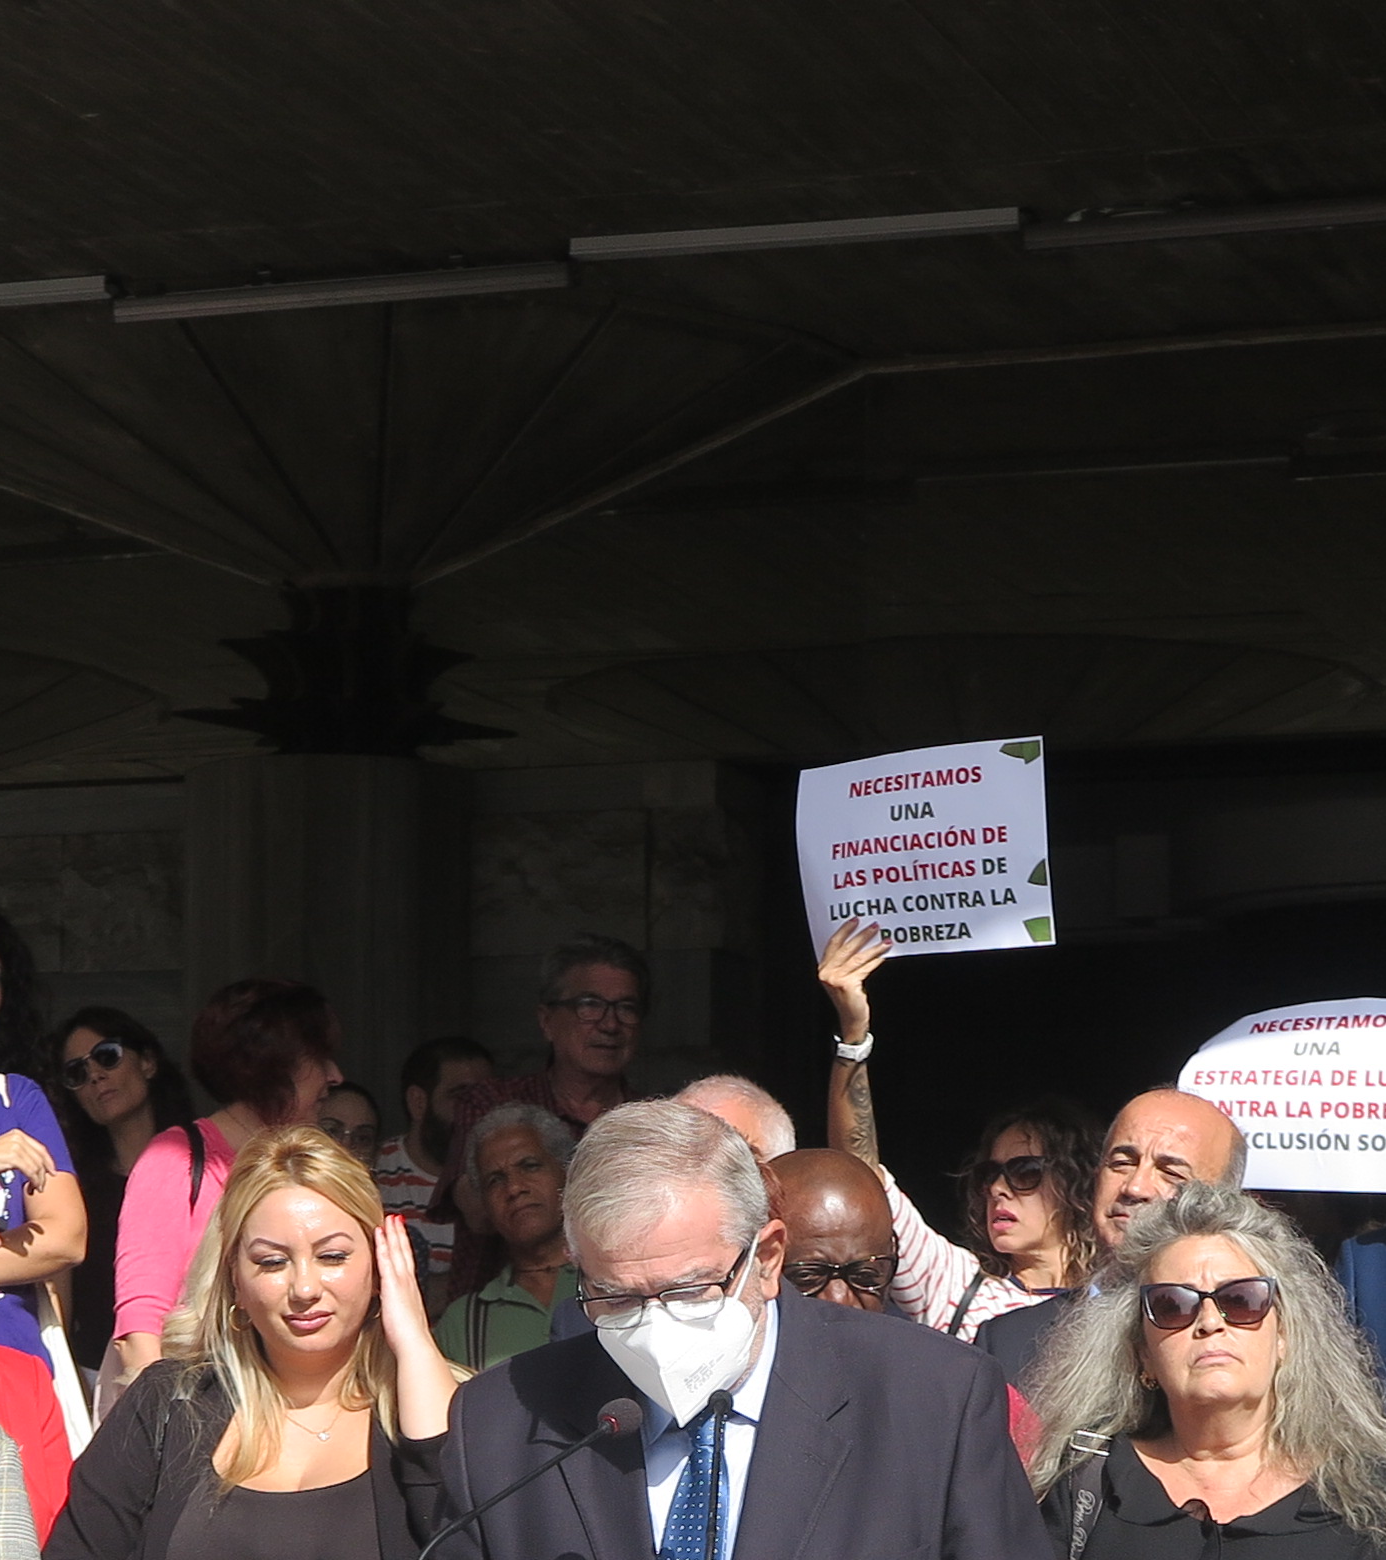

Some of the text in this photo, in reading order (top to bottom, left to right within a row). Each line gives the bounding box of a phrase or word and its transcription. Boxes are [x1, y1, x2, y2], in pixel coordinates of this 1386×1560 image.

[849, 766, 982, 798] NECESITAMOS
[889, 802, 935, 822] UNA
[831, 826, 1008, 860] FINANCIACIÓN DE
[833, 857, 1008, 890] LAS POLÍTICAS DE
[829, 888, 1017, 921] LUCHA CONTRA LA
[880, 922, 972, 945] POBREZA
[1293, 1041, 1341, 1056] UNA
[1194, 1069, 1323, 1086] ESTRATEGIA
[1330, 1070, 1357, 1086] DE
[1206, 1100, 1278, 1117] NTRA
[1285, 1101, 1313, 1118] LA
